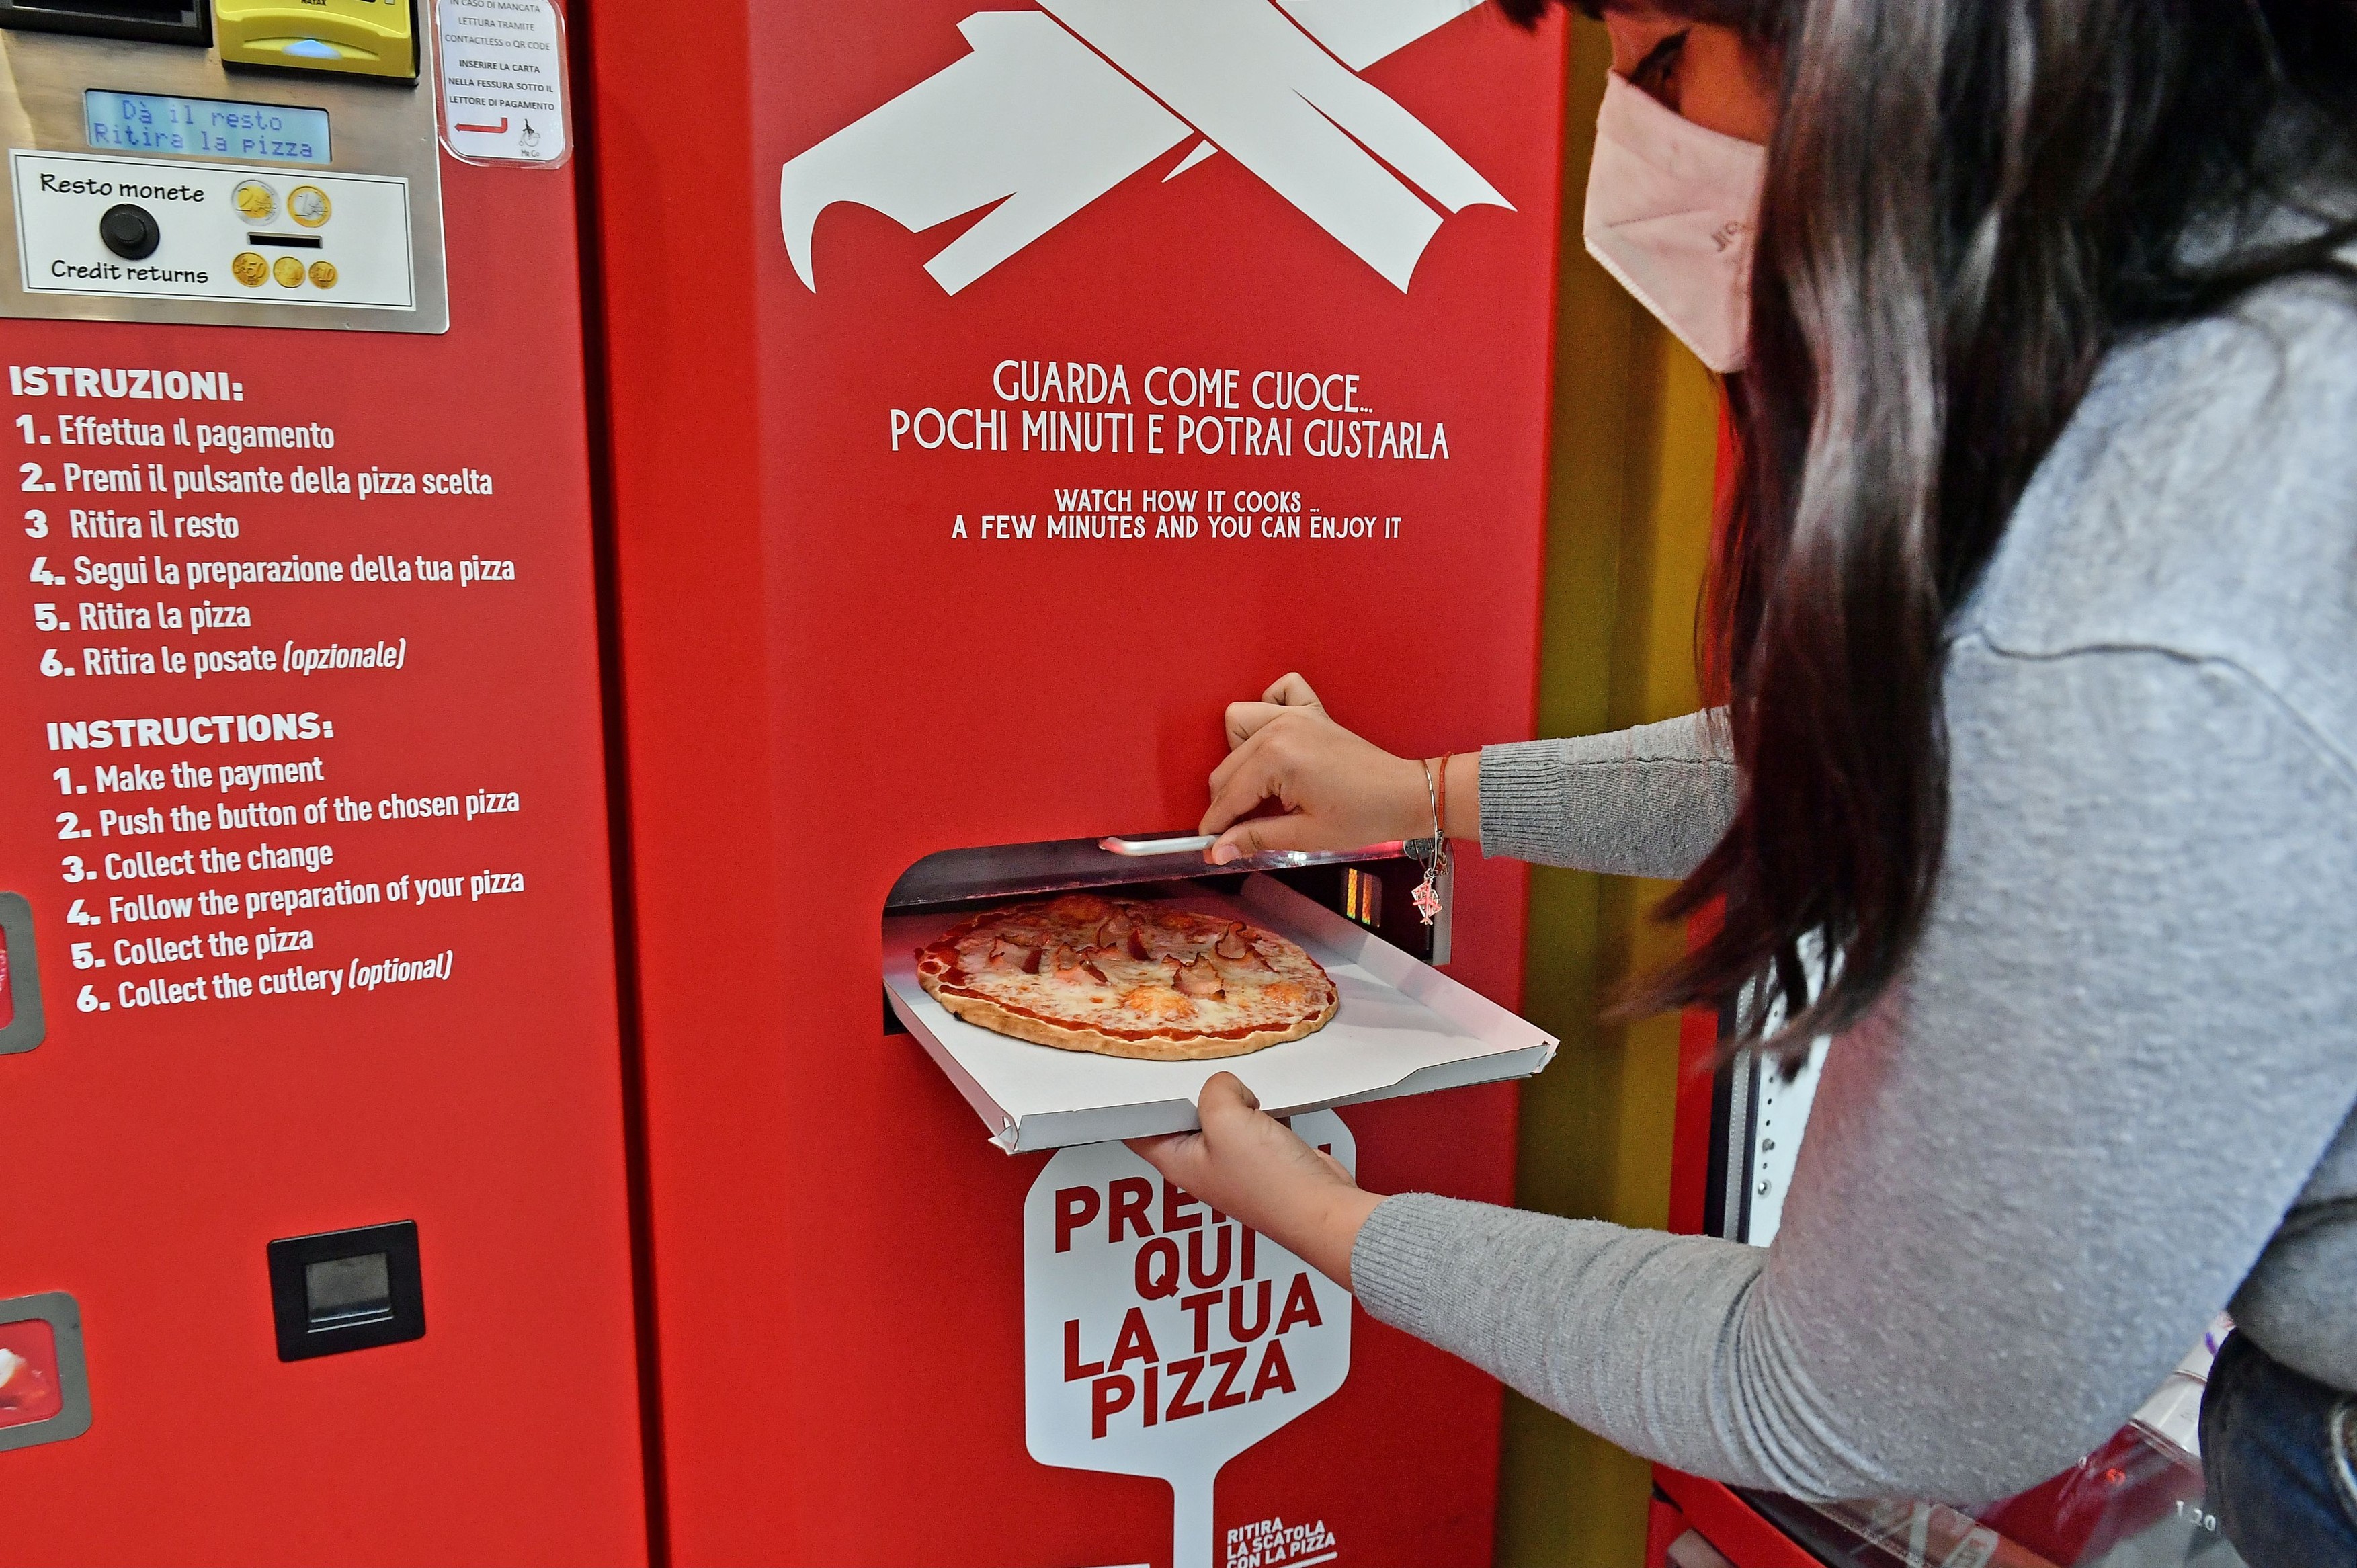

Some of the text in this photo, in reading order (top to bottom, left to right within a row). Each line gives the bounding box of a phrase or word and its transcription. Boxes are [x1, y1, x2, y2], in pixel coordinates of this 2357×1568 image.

[458, 17, 535, 31] LETTURA TRAMITE
[497, 3, 540, 13] MANCATA
[445, 34, 503, 46] CONTACTLESS
[513, 40, 526, 49] QR
[528, 42, 550, 50] CODE
[459, 59, 540, 73] INSERIRE LA CARTA
[448, 77, 554, 93] NELLA FESSURA SOTTO IL
[449, 95, 555, 110] LETTORE DI PAGAMENTO
[122, 100, 283, 131] Dà il resto
[94, 122, 313, 158] Ritira la pizza
[40, 173, 205, 202] Resto monete
[52, 259, 209, 284] Credit returns
[9, 366, 244, 401] ISTRUZIONI:
[993, 360, 1132, 405] GUARDA
[1144, 366, 1240, 409] COME
[15, 414, 335, 454] 1. Effettua il pagamento
[890, 407, 1450, 460] POCHI MINUTI E POTRAI GUSTARLA
[19, 462, 493, 501] 2. Premi il pulsante della pizza scelta
[1053, 489, 1132, 513] WATCH
[1143, 489, 1198, 513] HOW
[1207, 490, 1226, 513] IT
[1233, 491, 1302, 513] COOKS
[24, 509, 239, 539] 3 Ritira il resto
[951, 515, 1402, 539] A FEW MINUTES AND YOU CAN ENJOY IT
[29, 554, 515, 591] 4. Segui la preparazione della tua pizza
[34, 600, 251, 635] 5. Ritira la pizza
[40, 637, 407, 679] 6. Ritira le posate (opzionale)
[46, 712, 334, 751] INSTRUCTIONS:
[52, 756, 325, 795] 1. Make the payment
[56, 788, 520, 840] 2. Push the button of the chosen pizza
[61, 843, 334, 883] 3. Collect the change
[66, 869, 524, 926] 4. Follow the preparation of your pizza
[70, 926, 314, 970] 5. Collect the pizza
[76, 950, 453, 1012] 6. Collect the cutlery (optional)
[1135, 1224, 1255, 1301] QUI
[1064, 1272, 1323, 1383] LA TUA
[1091, 1339, 1296, 1440] PIZZA
[1227, 1516, 1283, 1544] RITIRA
[1227, 1520, 1326, 1560] LA SCATOLA
[1265, 1546, 1286, 1565] LA
[1290, 1532, 1336, 1557] PIZZA
